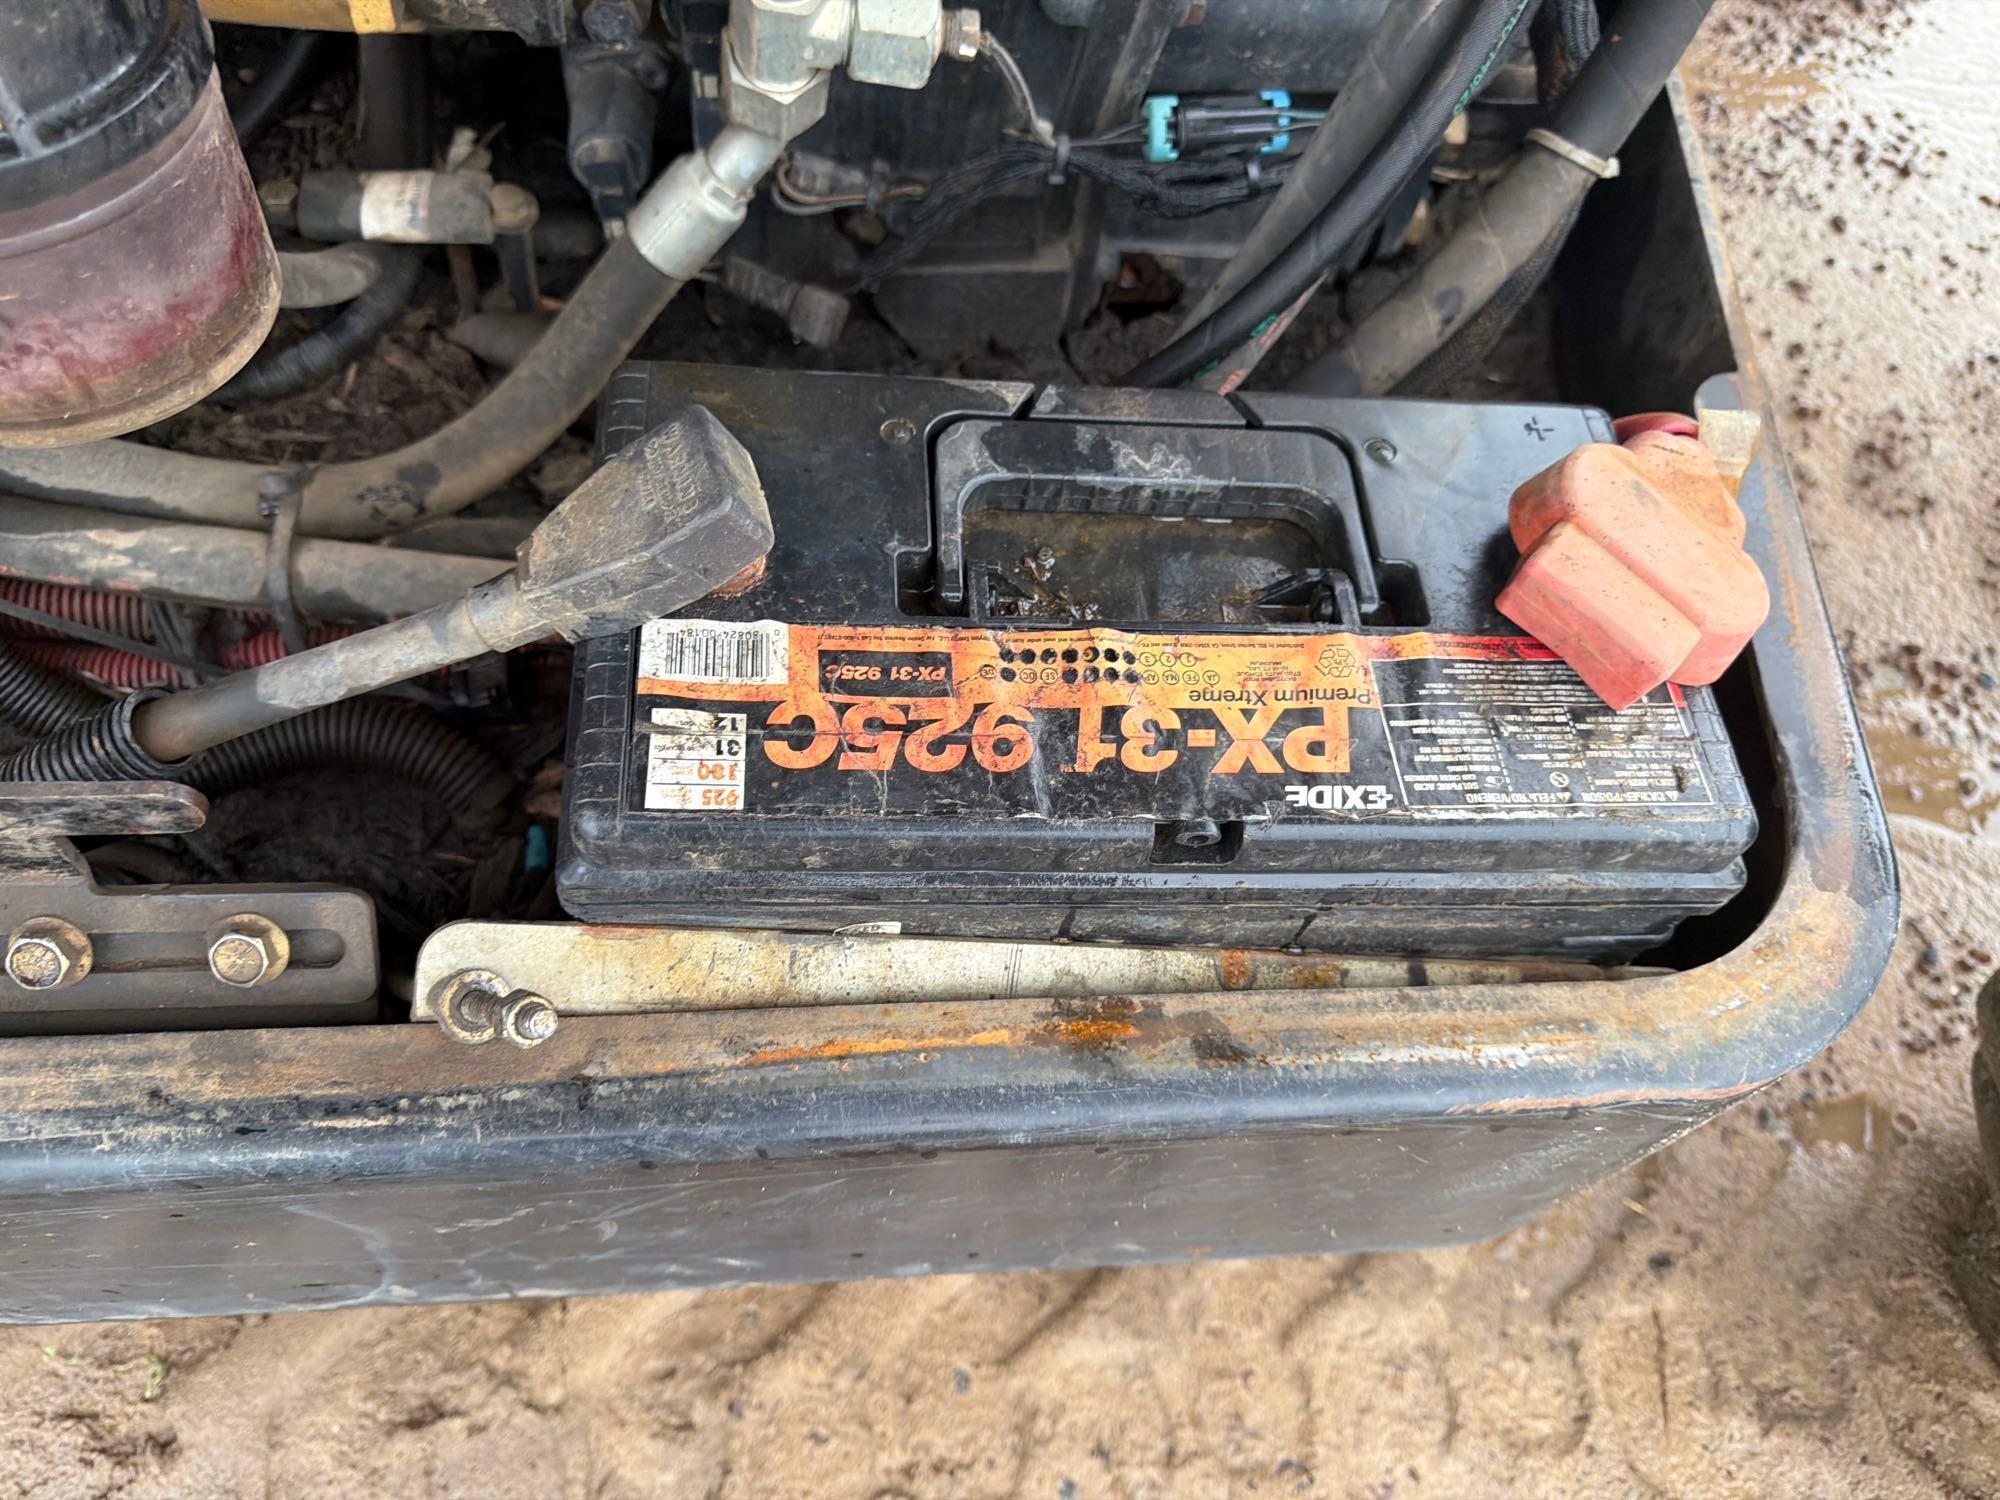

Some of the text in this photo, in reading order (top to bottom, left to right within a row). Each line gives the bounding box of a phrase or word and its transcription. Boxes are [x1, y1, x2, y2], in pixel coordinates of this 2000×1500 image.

[680, 628, 716, 638] 00184
[723, 630, 759, 639] 80824
[824, 664, 946, 681] PX-31 925C
[1188, 687, 1371, 706] Premium Xtreme
[714, 716, 738, 732] 12
[762, 700, 1036, 773] 925C
[1075, 704, 1350, 774] PX-31
[716, 739, 740, 756] 31
[702, 789, 740, 806] 925
[1284, 784, 1392, 810] EXIDE
